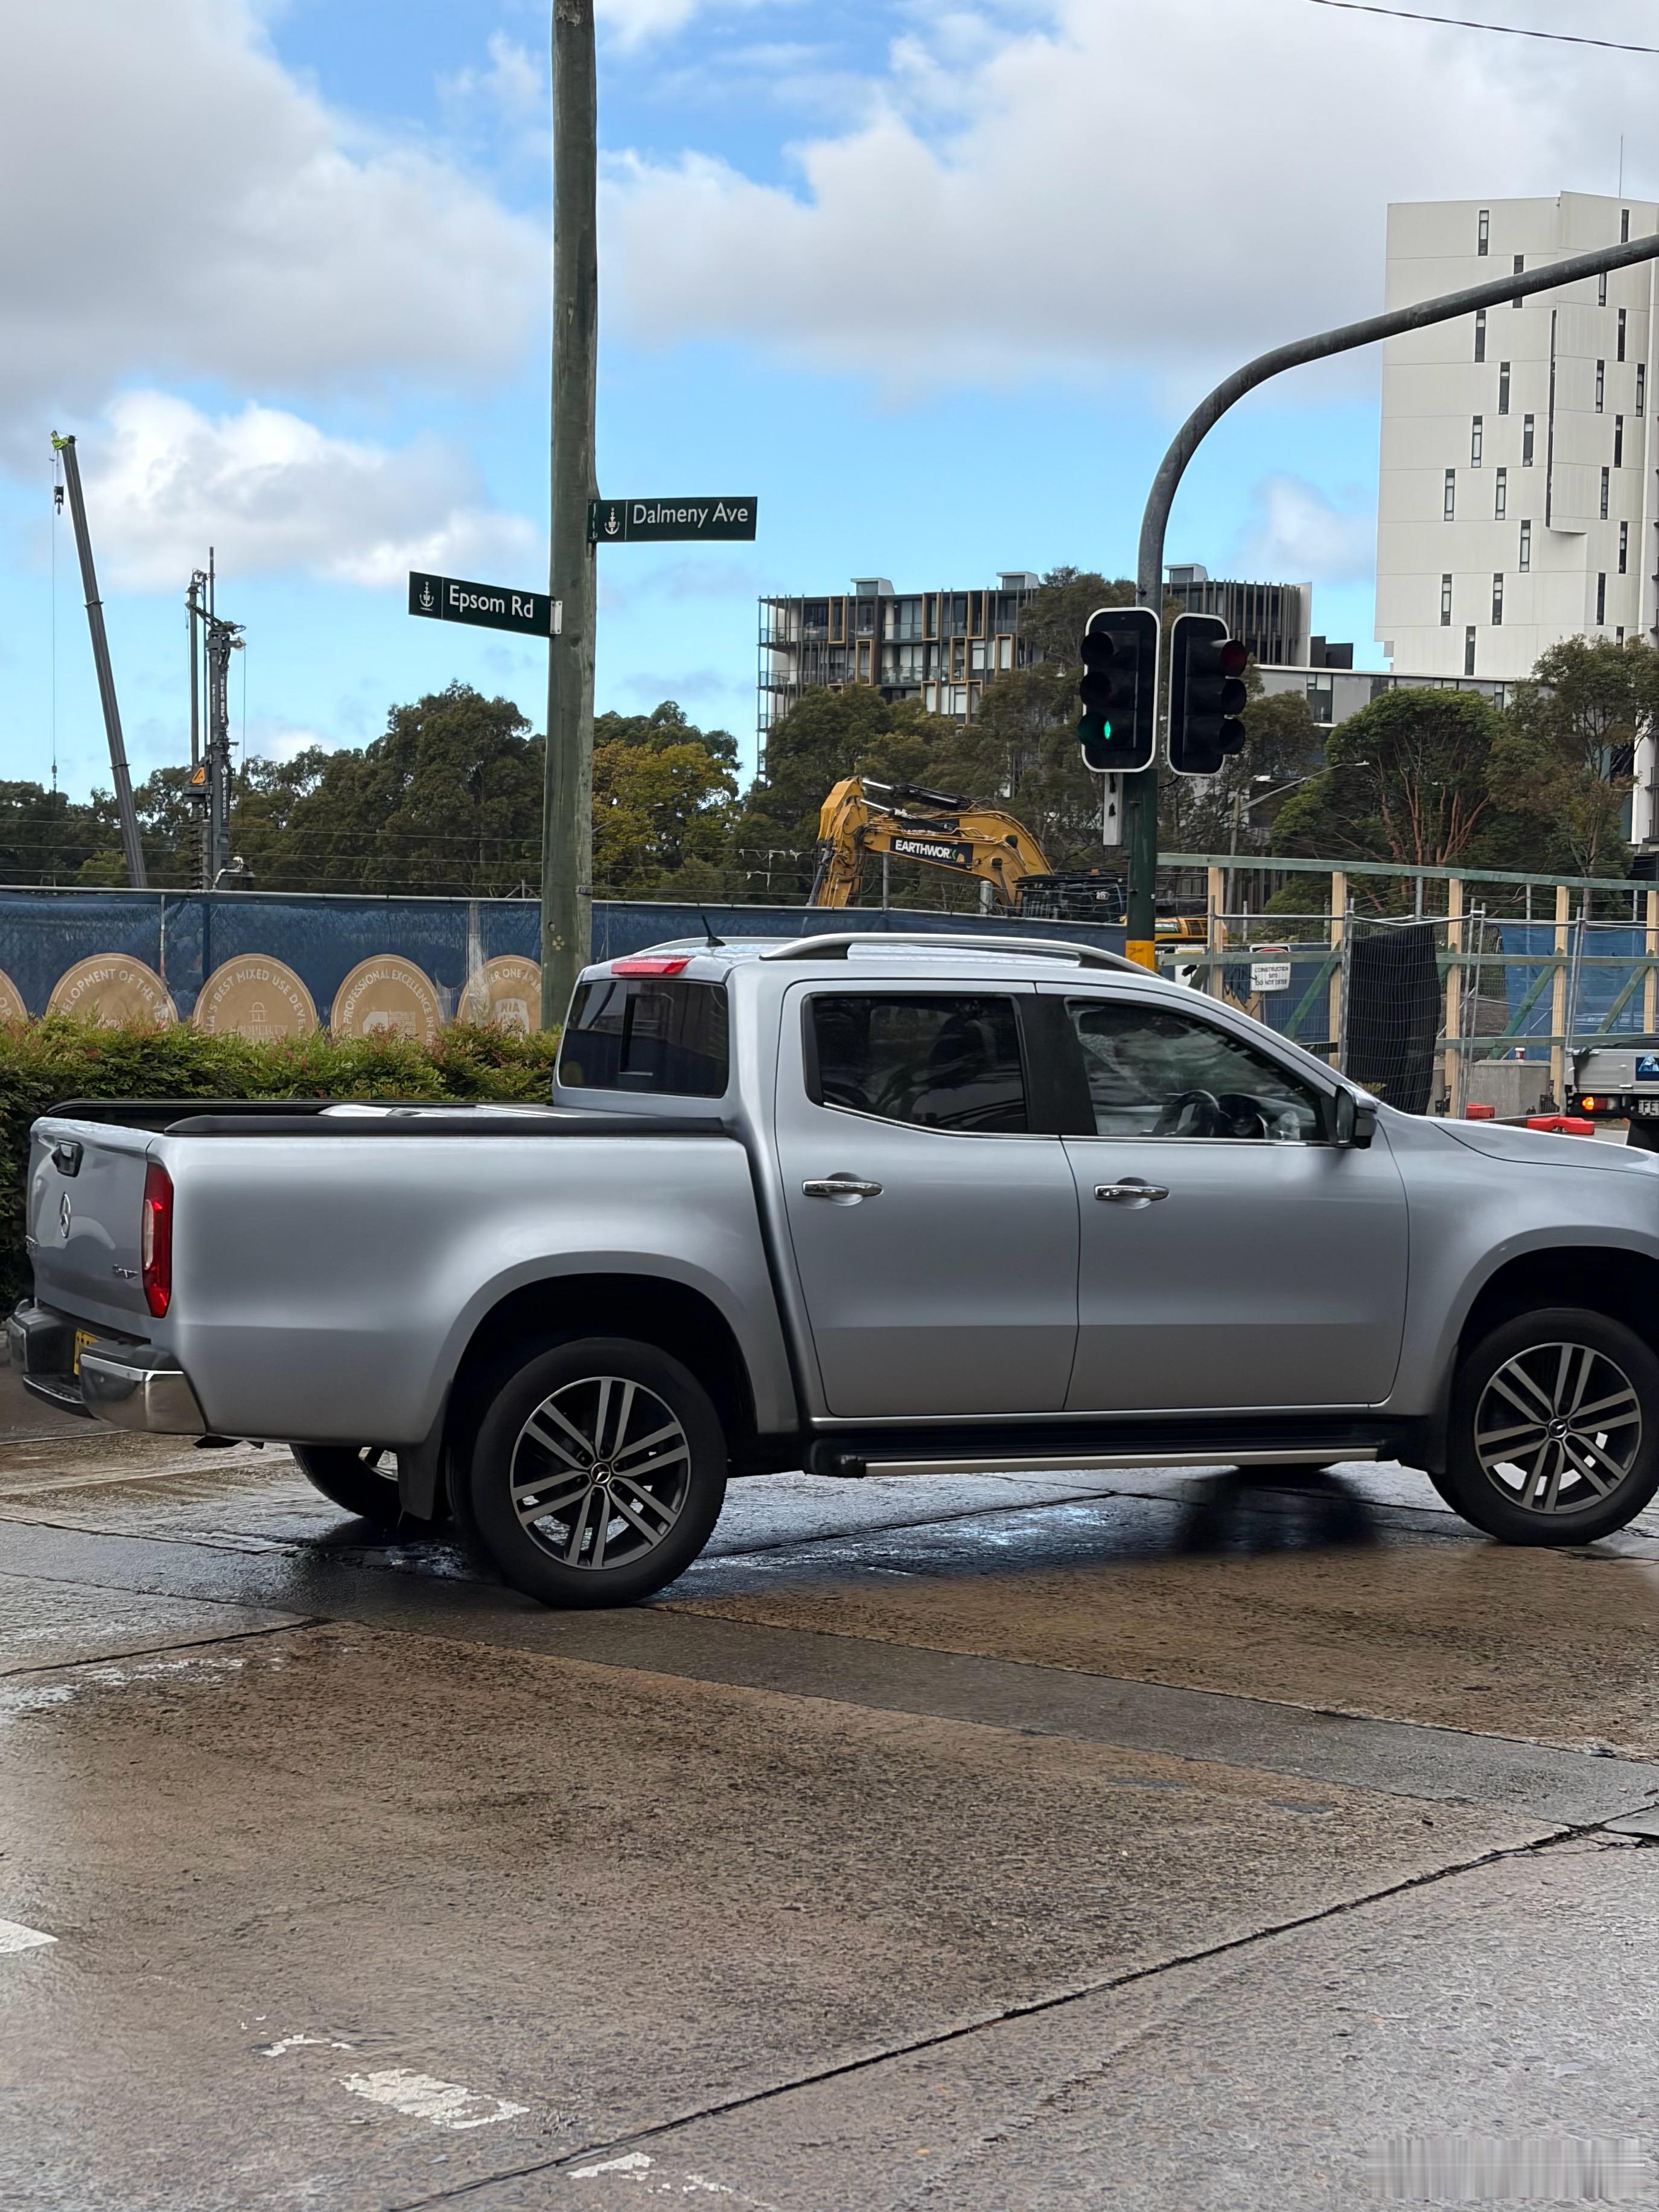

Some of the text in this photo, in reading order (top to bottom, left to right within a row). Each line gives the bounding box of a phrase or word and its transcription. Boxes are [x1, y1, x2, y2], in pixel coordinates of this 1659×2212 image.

[633, 502, 748, 528] Dalmeny Ave
[449, 584, 533, 619] Epsom Rd
[119, 970, 135, 984] OF
[136, 978, 155, 1002] THE
[213, 975, 234, 1002] BEST
[236, 968, 270, 983] MIXED
[272, 975, 291, 995] USE
[502, 967, 522, 978] ONE
[343, 968, 390, 1024] PROFESSIONAL
[392, 969, 433, 1015] EXCELLENCE
